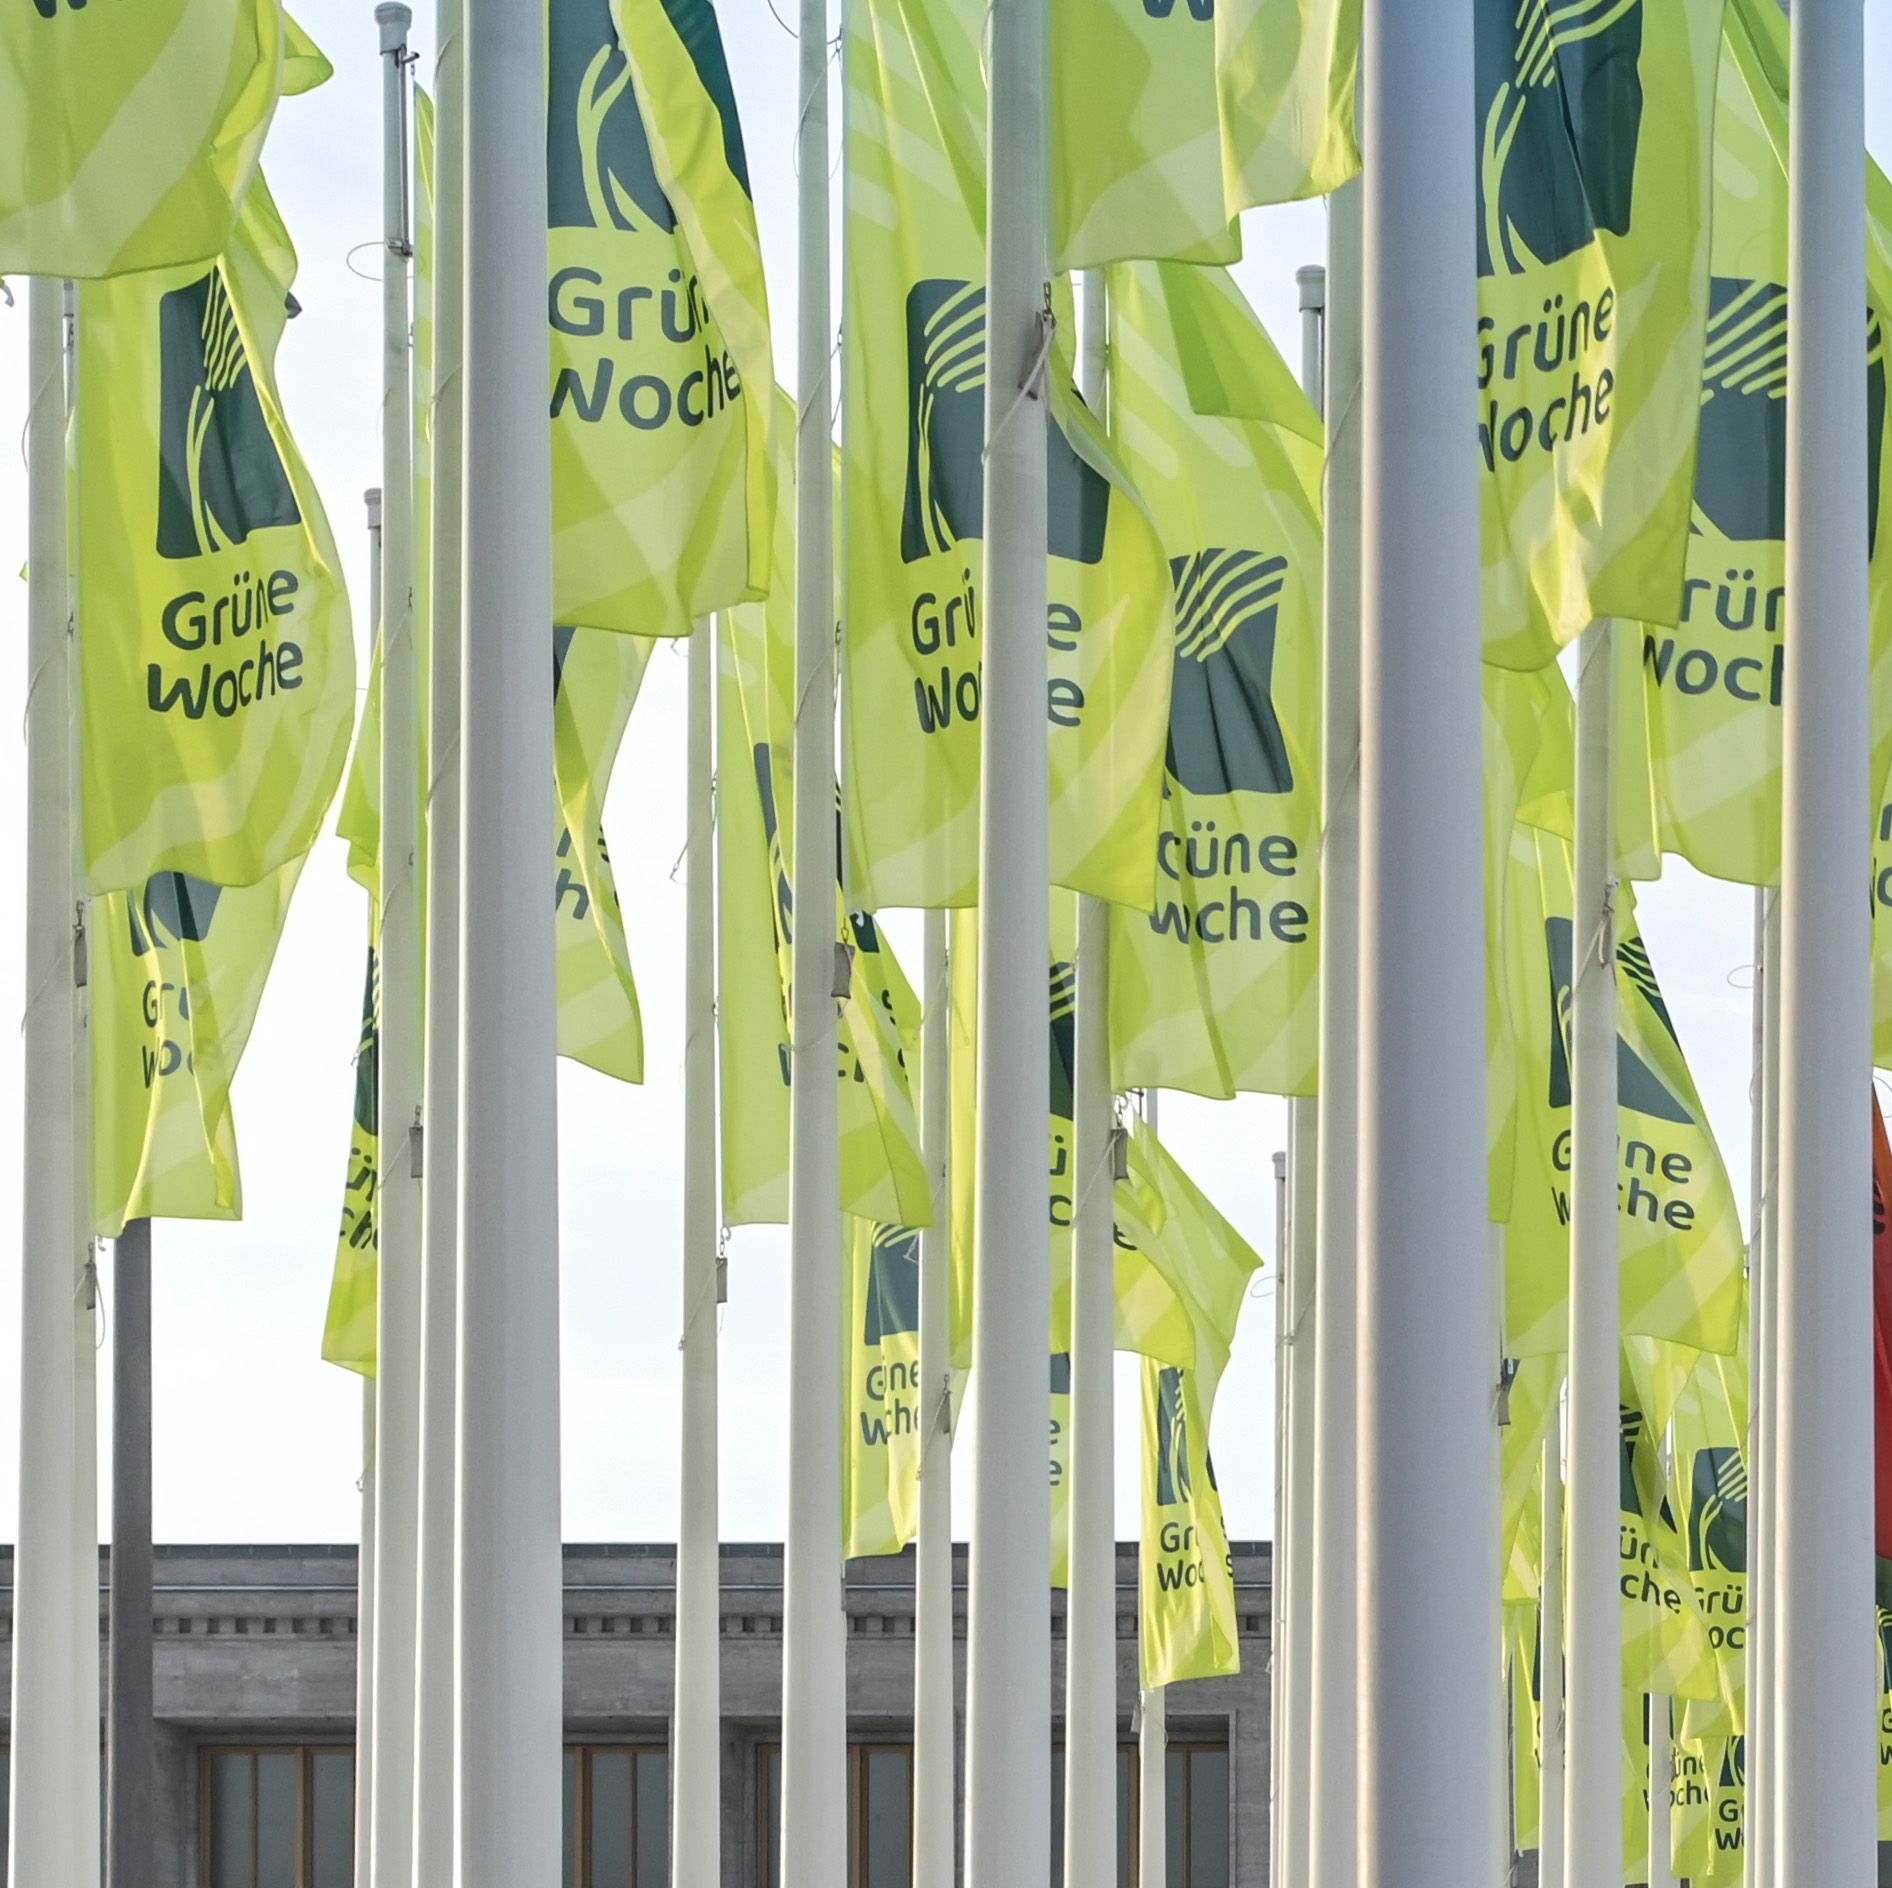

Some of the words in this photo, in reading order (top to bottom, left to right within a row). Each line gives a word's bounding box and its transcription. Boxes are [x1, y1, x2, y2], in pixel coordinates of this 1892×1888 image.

[162, 570, 298, 650] Grüne
[912, 568, 1082, 655] Grüe
[148, 640, 303, 719] Woche
